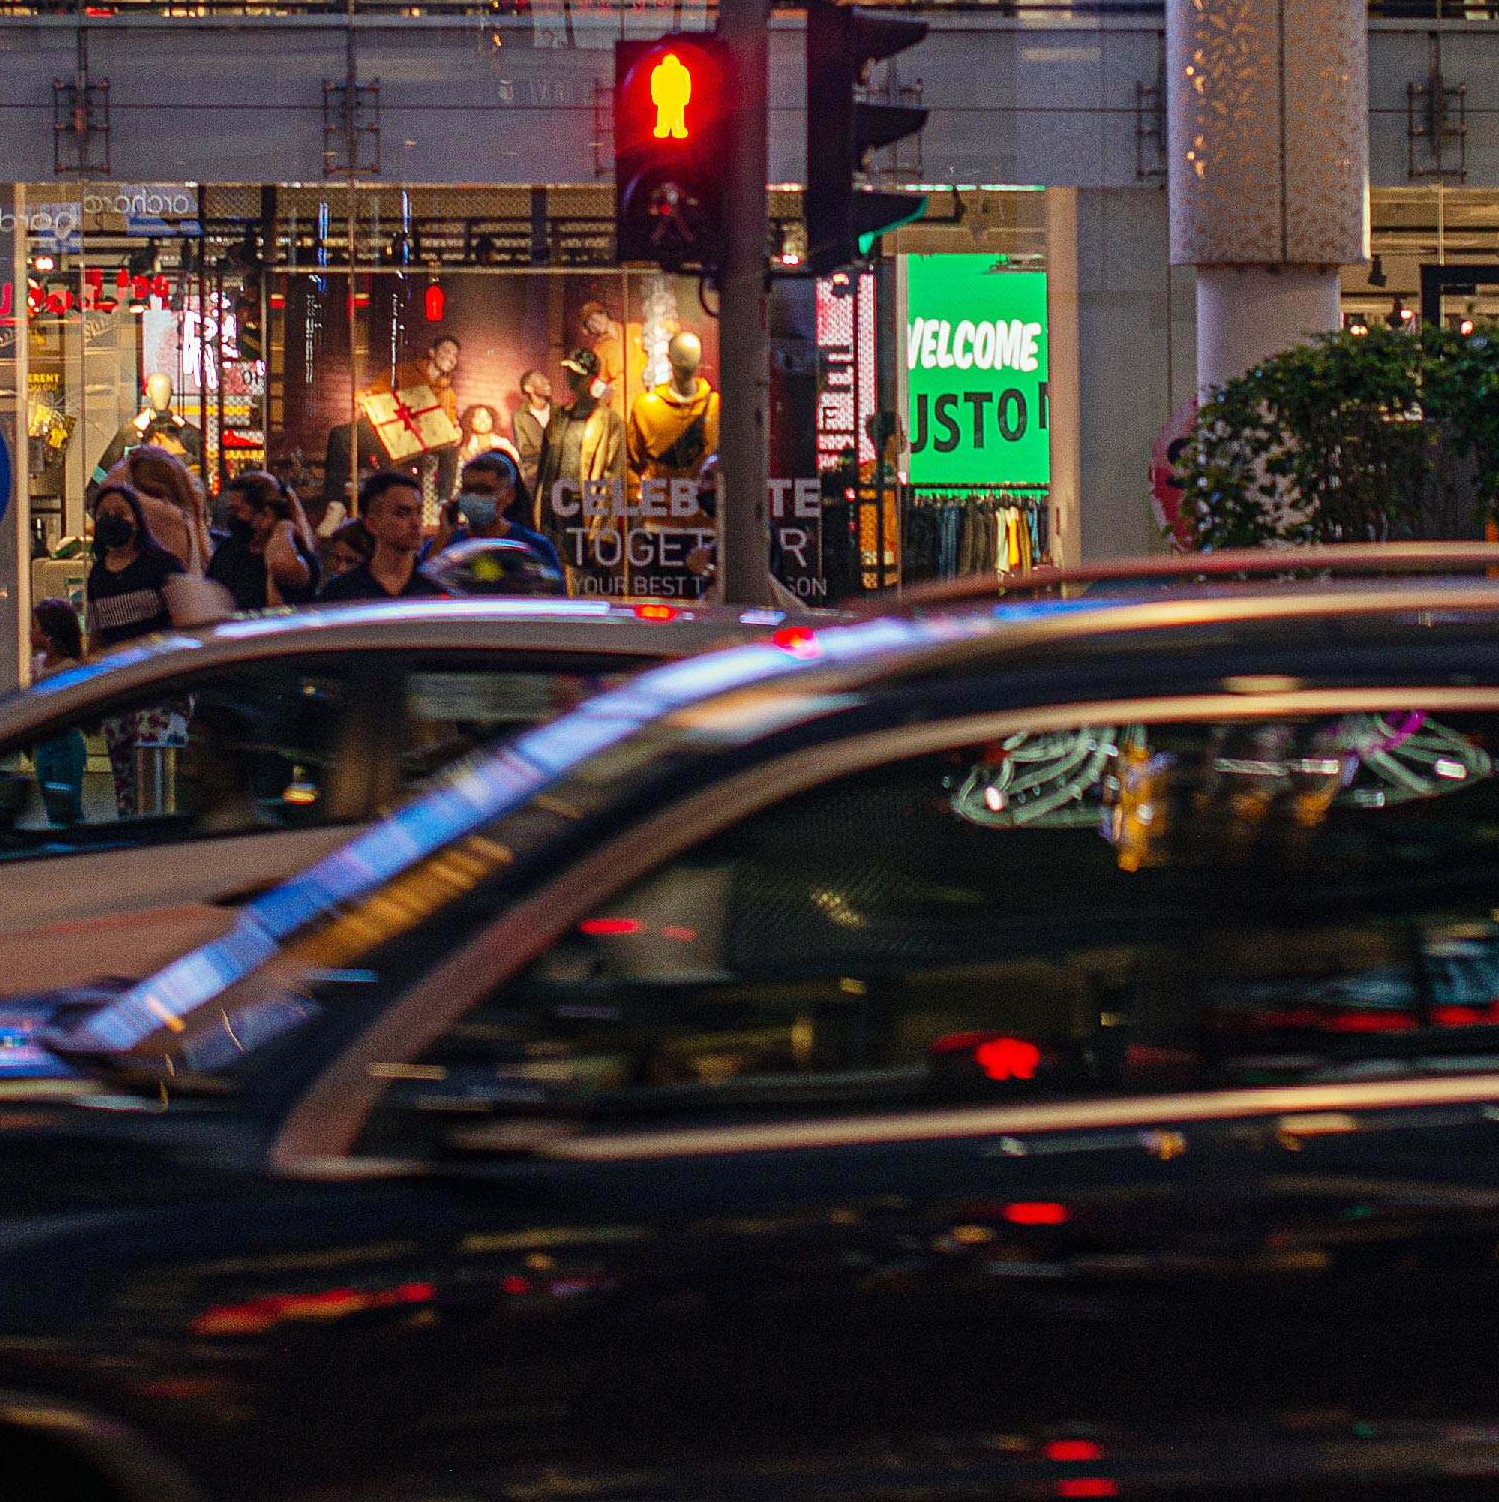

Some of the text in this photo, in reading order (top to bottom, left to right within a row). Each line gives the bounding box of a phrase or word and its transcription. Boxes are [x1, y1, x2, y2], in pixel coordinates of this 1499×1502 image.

[909, 382, 1049, 454] USTO
[551, 477, 823, 518] CELEBTE
[572, 576, 627, 596] YOUR
[633, 575, 686, 596] BEST
